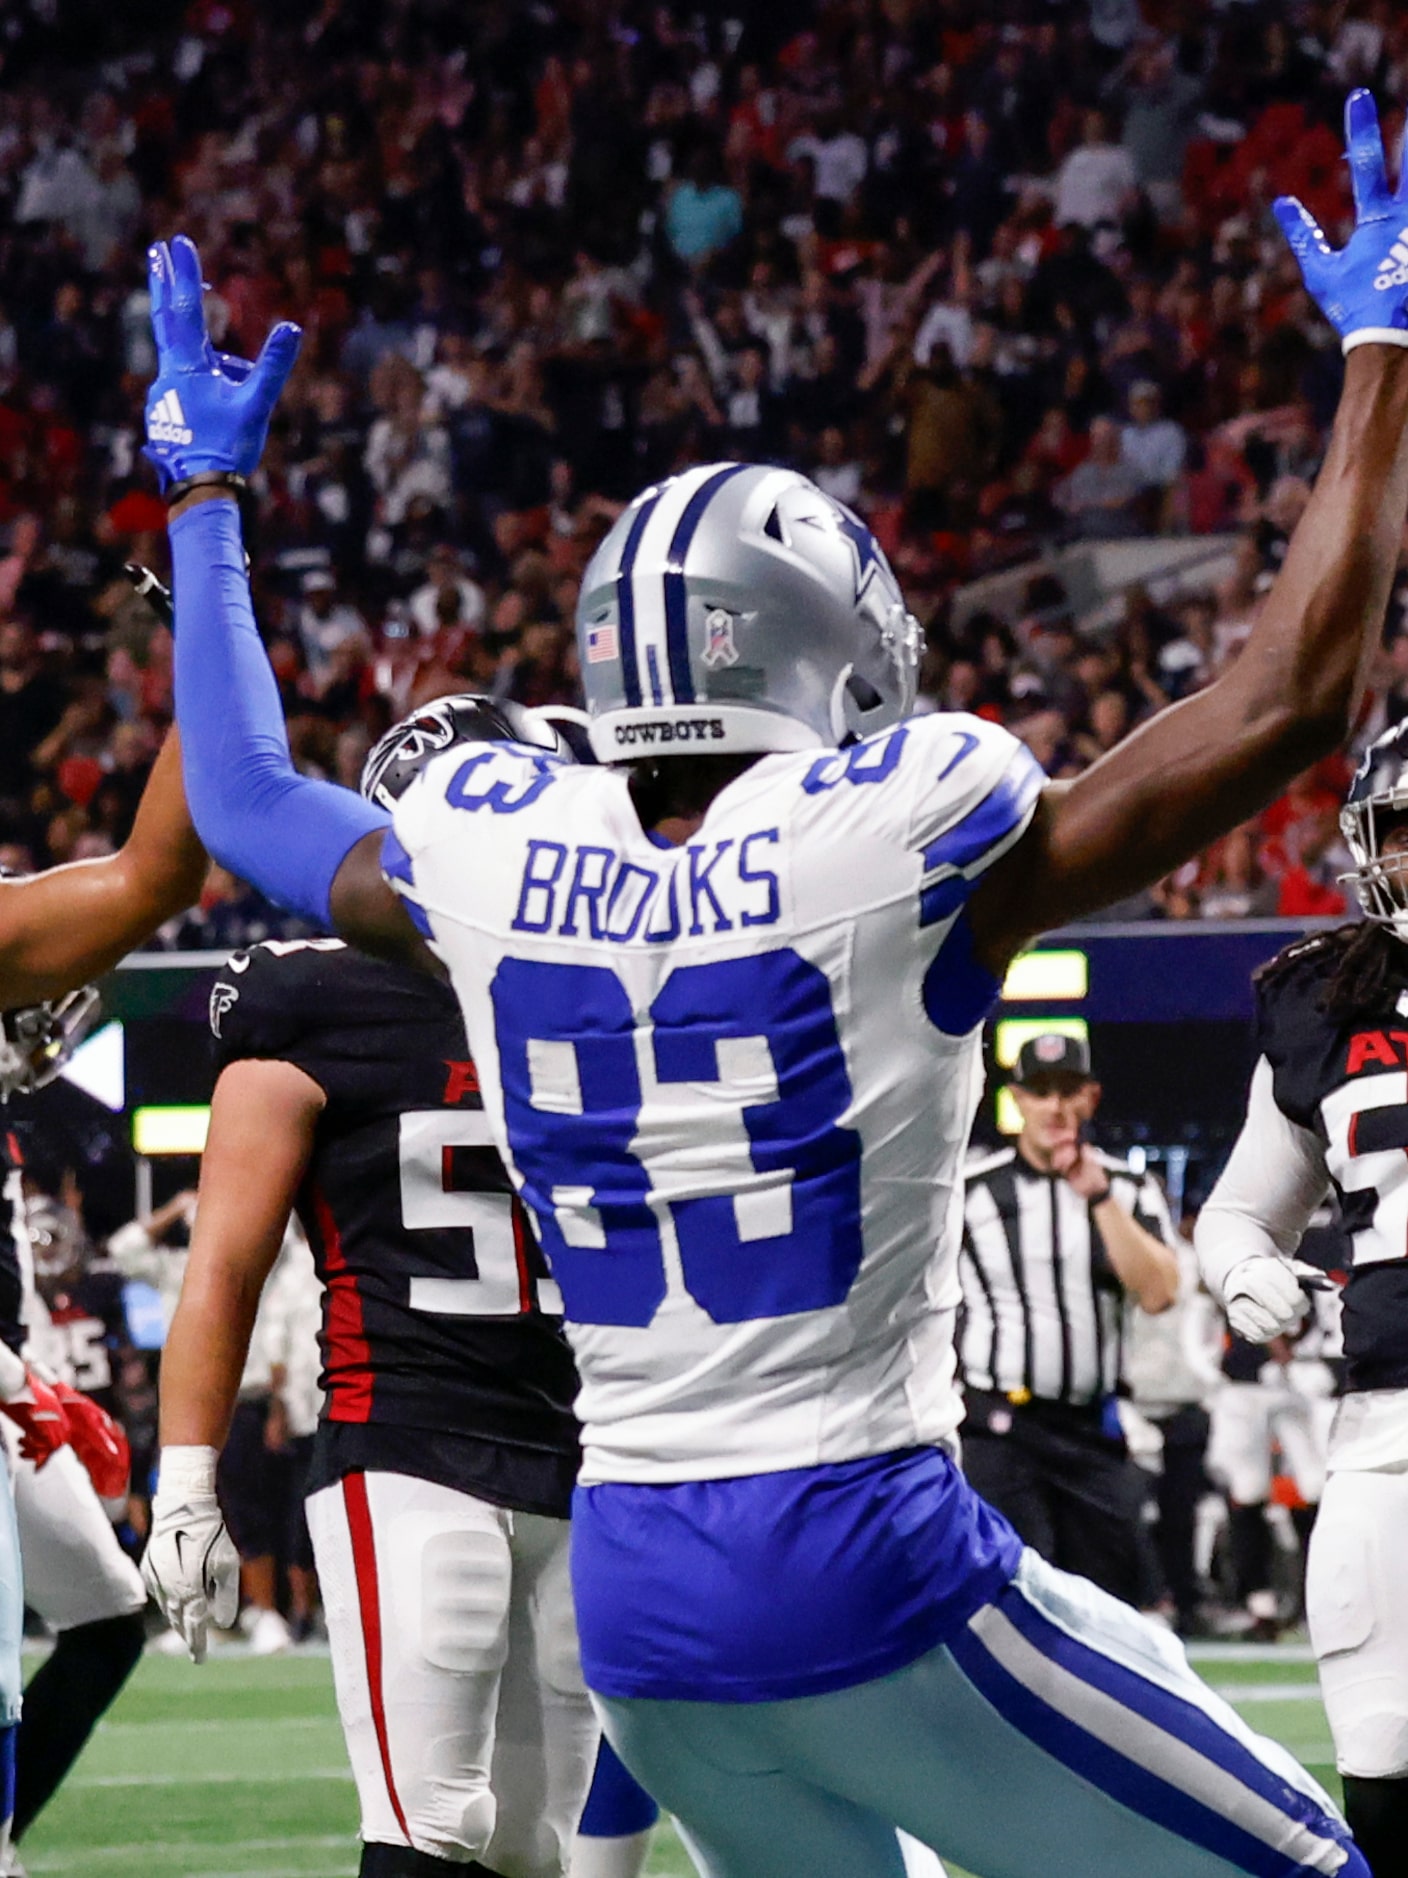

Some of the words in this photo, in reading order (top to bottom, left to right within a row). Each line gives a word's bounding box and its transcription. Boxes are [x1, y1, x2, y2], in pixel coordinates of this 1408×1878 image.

[615, 718, 725, 744] COWBOYS
[511, 827, 780, 943] BROOKS
[399, 1110, 565, 1316] 5
[490, 947, 863, 1328] 83
